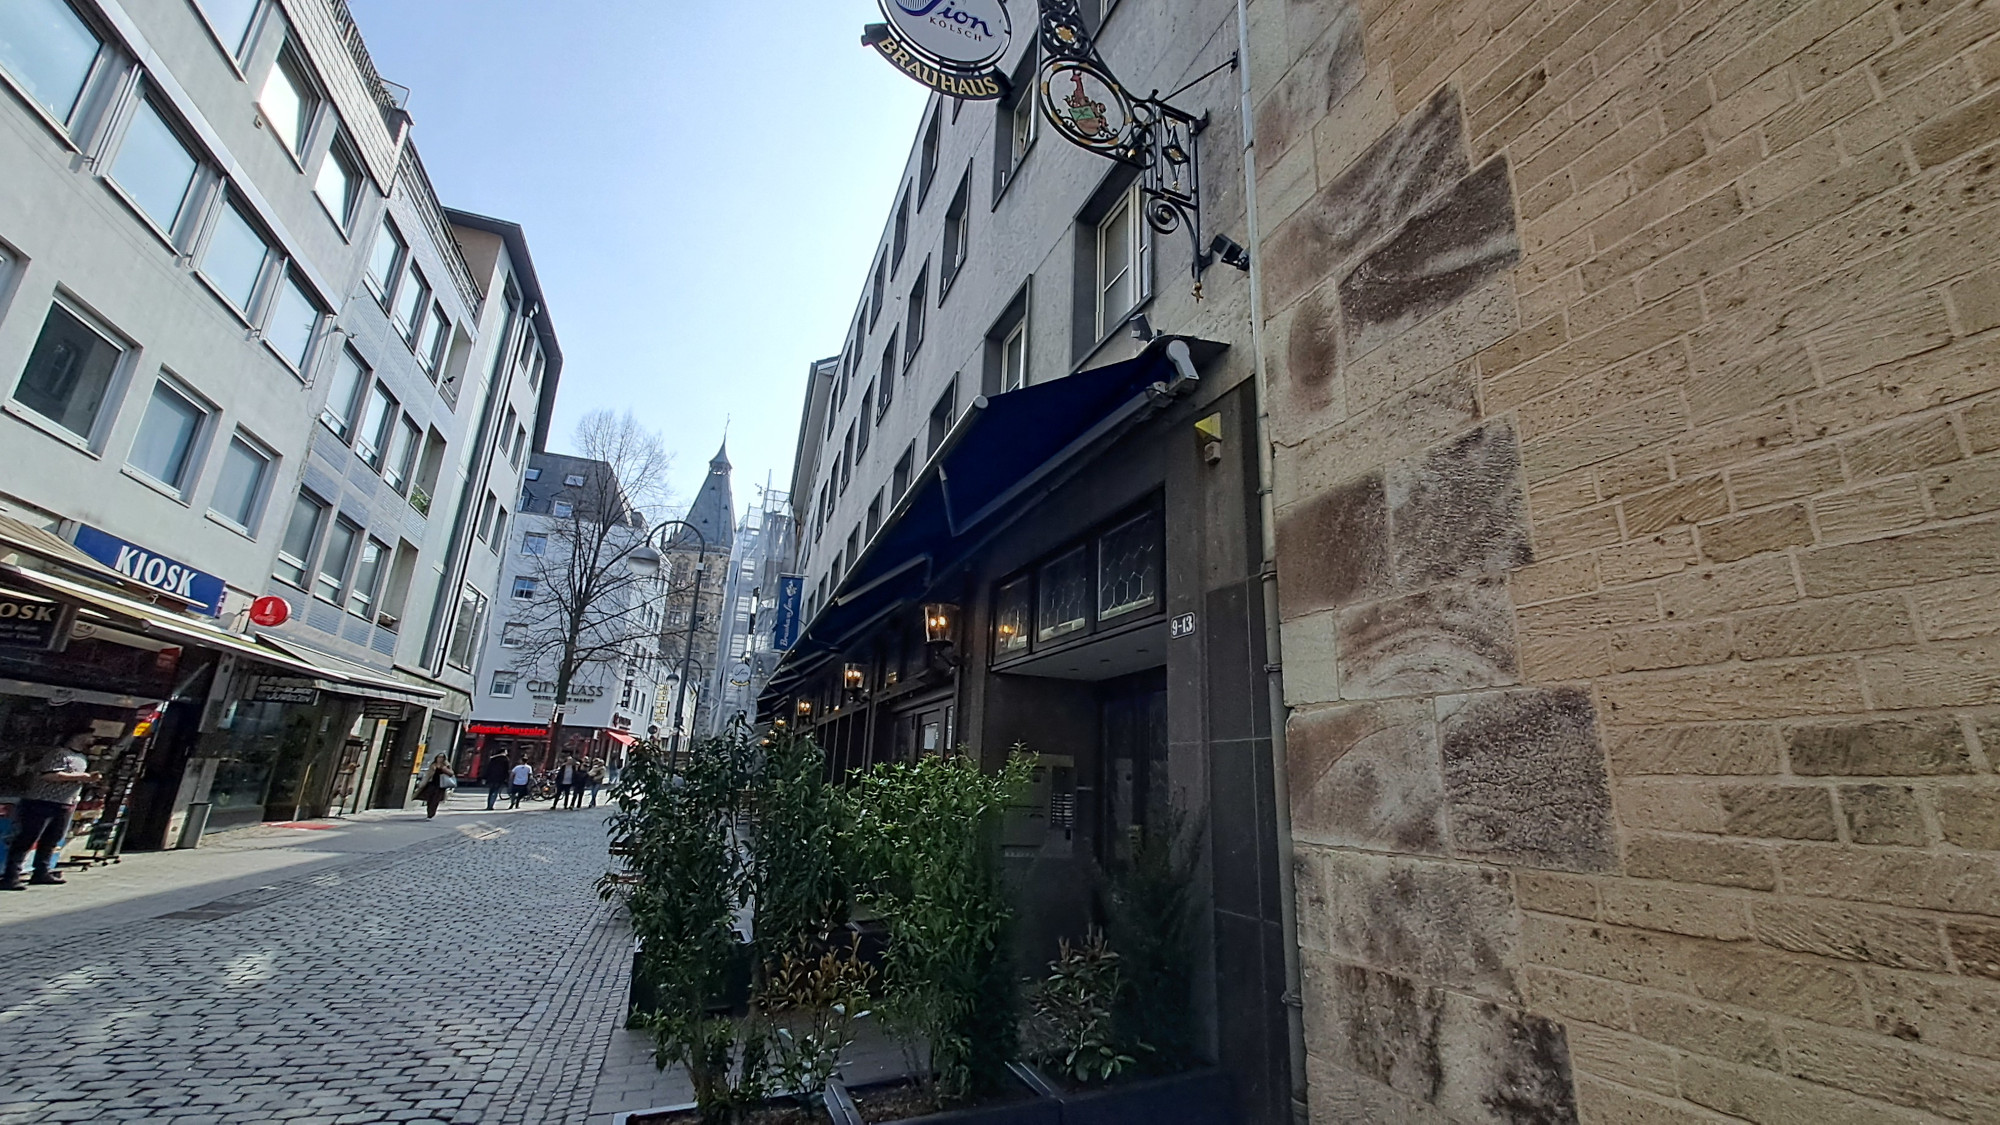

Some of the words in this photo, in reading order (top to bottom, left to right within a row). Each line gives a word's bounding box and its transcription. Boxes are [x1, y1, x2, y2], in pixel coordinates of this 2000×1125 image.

[878, 37, 999, 97] BRAUHAUS
[114, 544, 198, 598] KIOSK
[1171, 615, 1193, 635] 9-13
[526, 680, 559, 694] CITY
[566, 683, 604, 697] LASS
